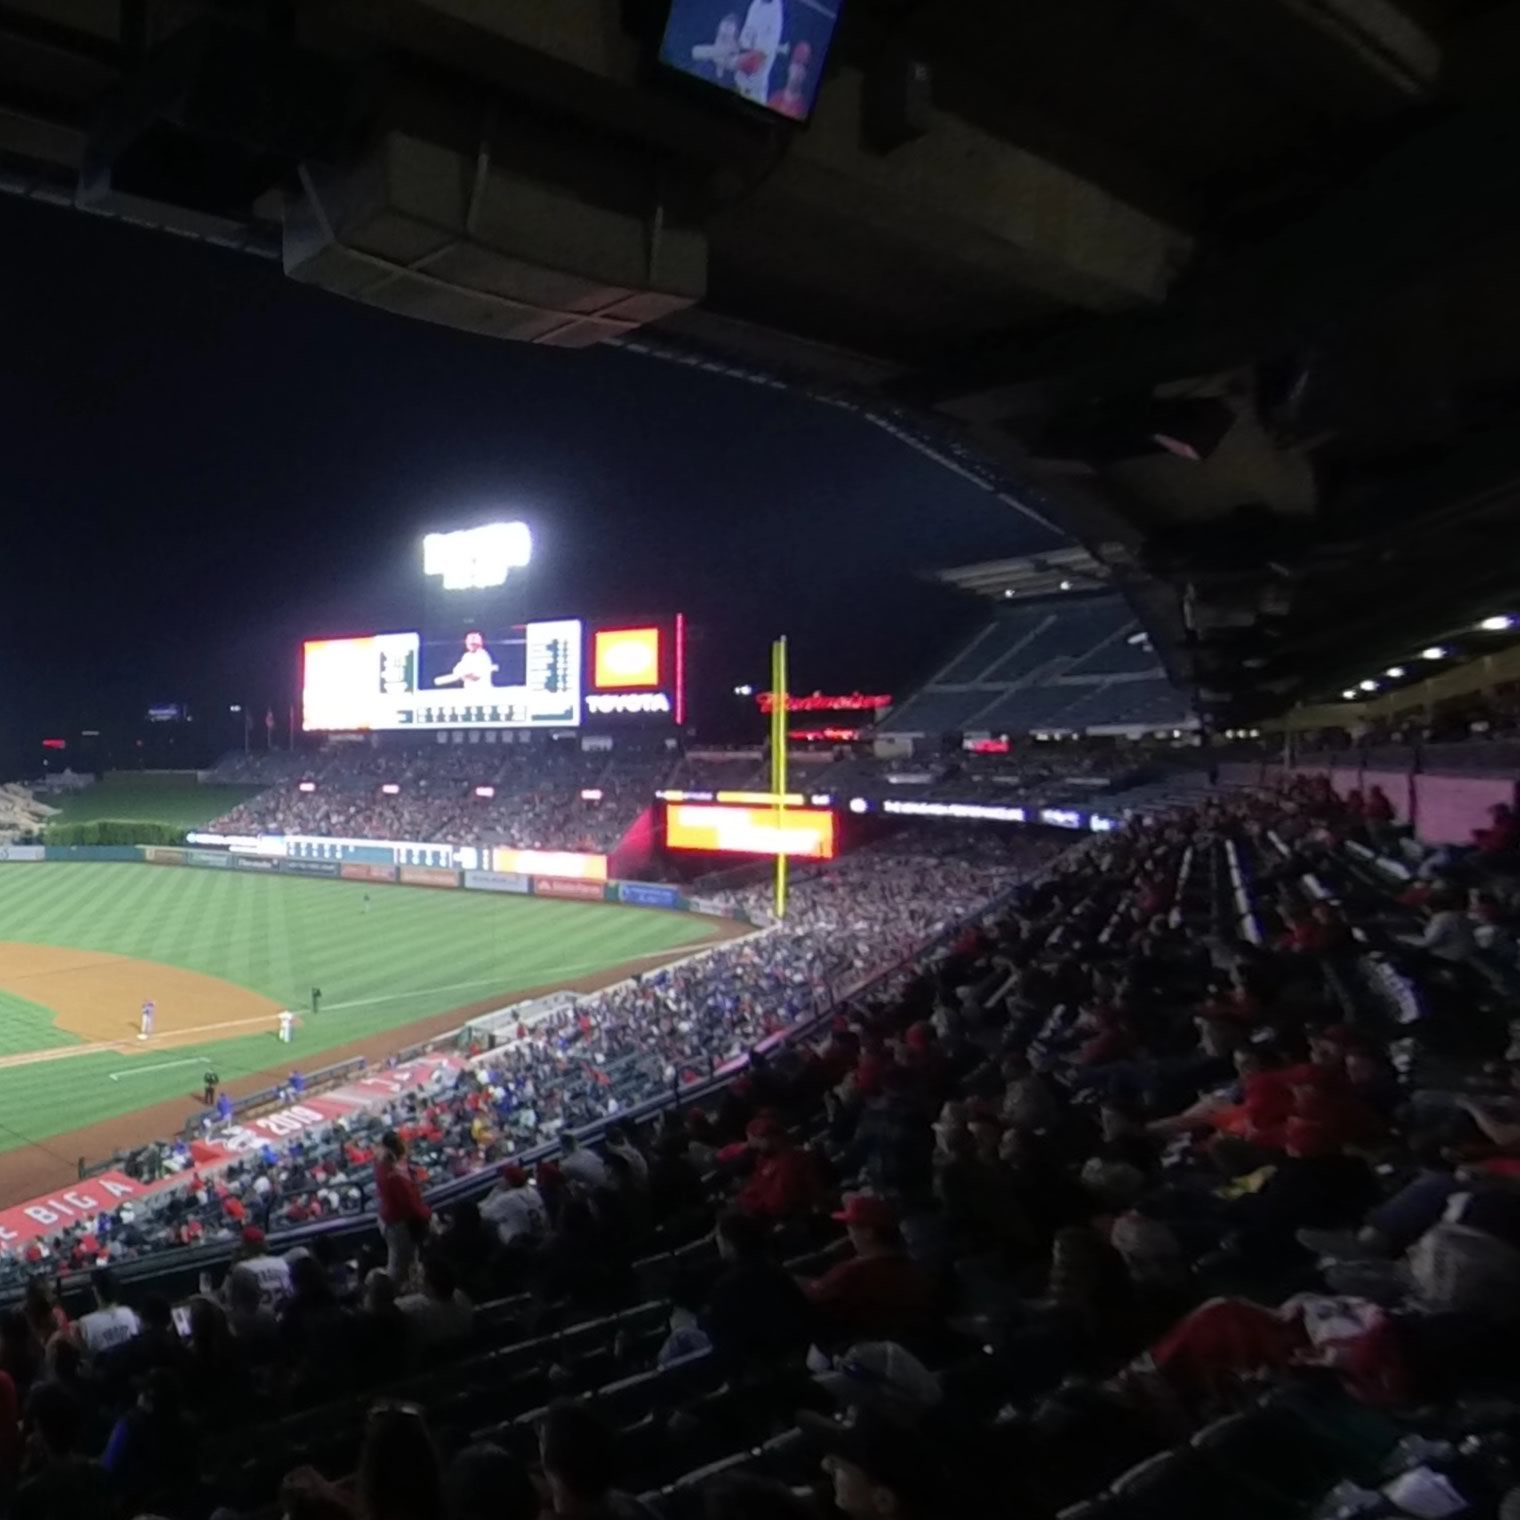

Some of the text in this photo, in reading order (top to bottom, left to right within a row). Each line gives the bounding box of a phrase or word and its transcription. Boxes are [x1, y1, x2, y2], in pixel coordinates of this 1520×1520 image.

[585, 692, 670, 714] TOYOTA
[23, 1190, 98, 1225] BIG
[98, 1178, 134, 1198] A
